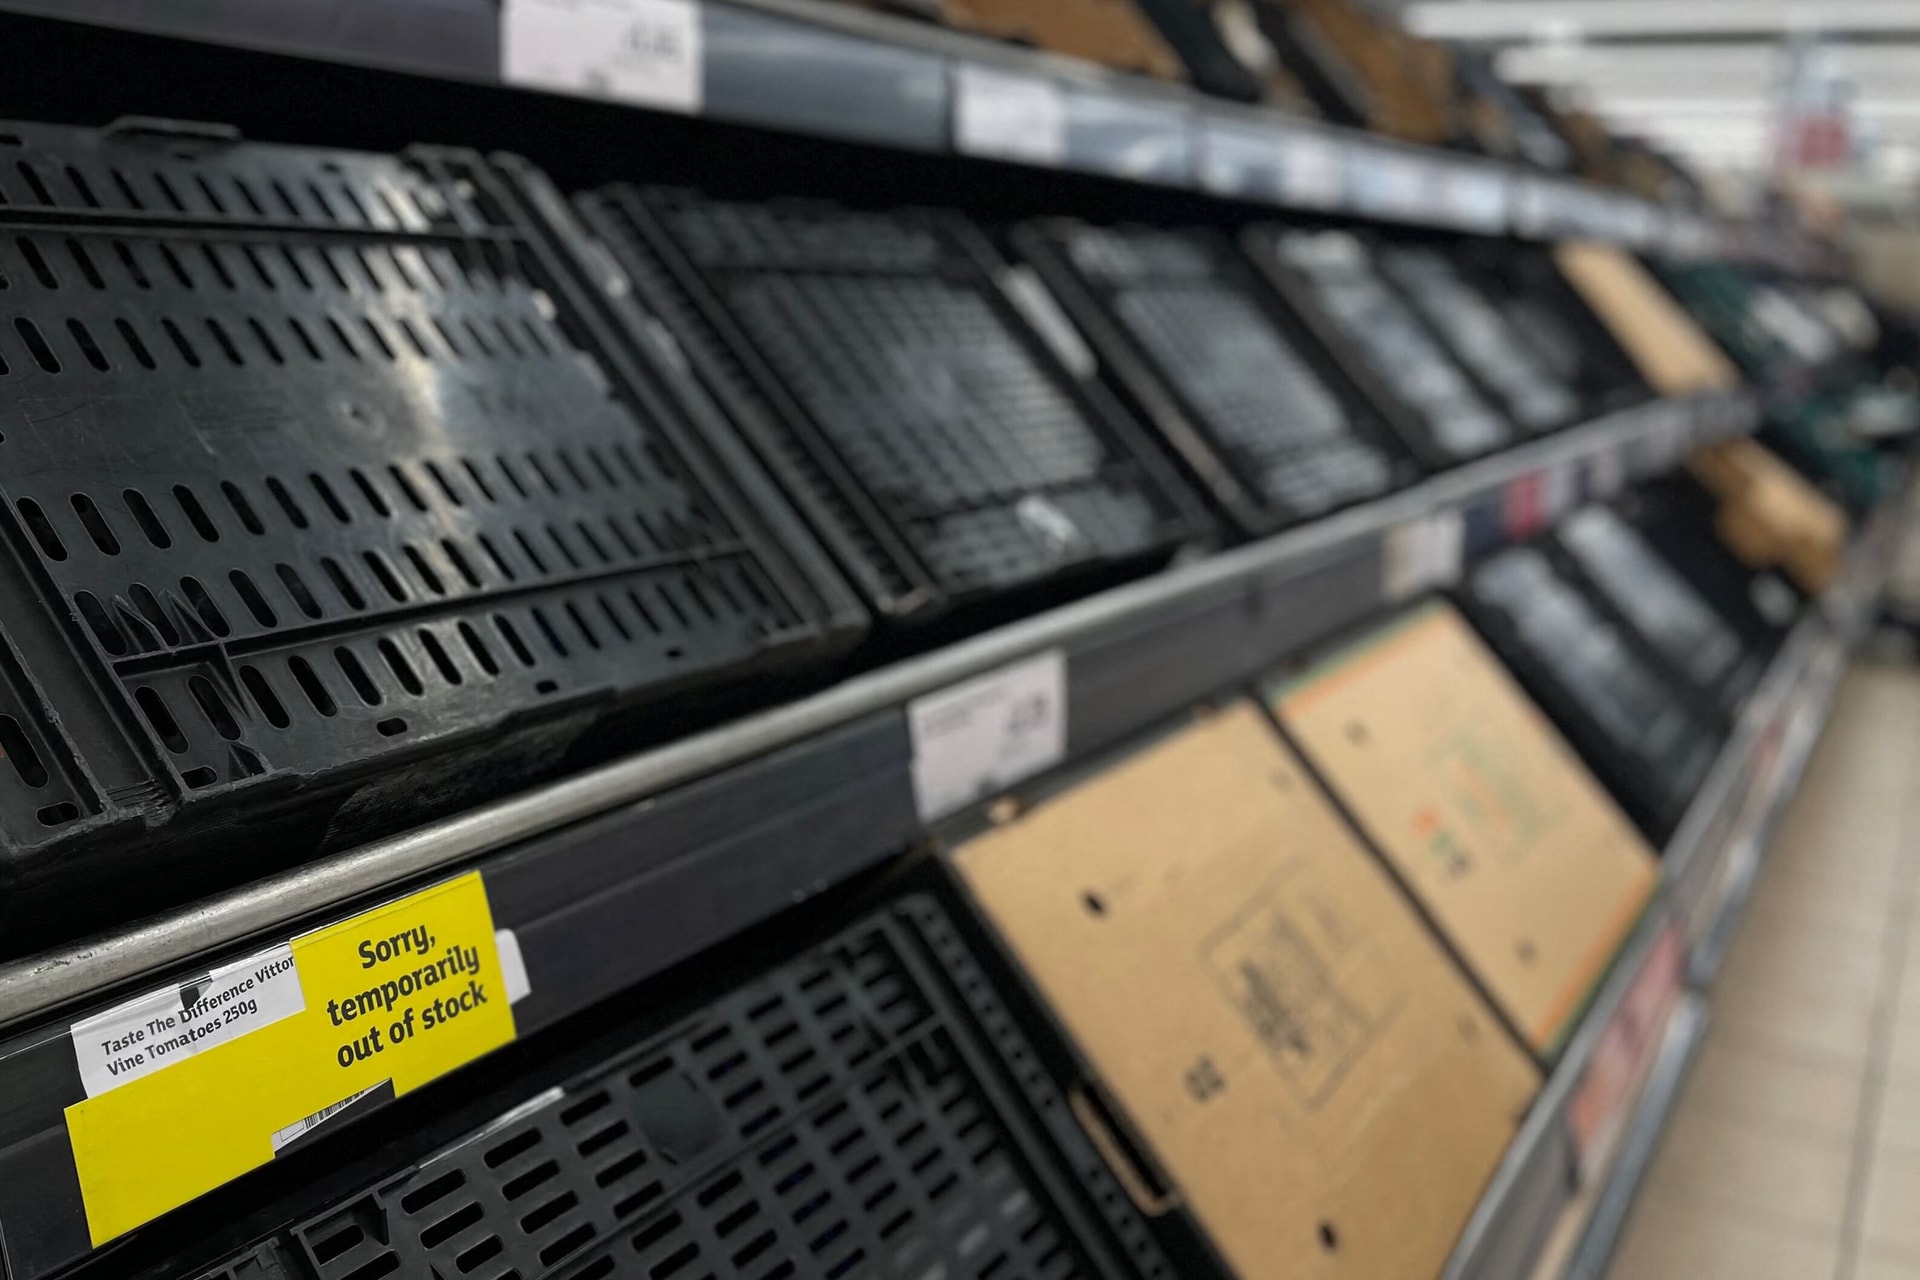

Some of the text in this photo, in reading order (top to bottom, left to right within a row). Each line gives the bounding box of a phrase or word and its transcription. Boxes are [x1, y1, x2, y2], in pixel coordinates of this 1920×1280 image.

[327, 945, 480, 1027] temporarily
[358, 925, 436, 969] Sorry,
[101, 1030, 145, 1056] Taste
[147, 1016, 176, 1036] The
[178, 978, 255, 1024] Difference
[107, 998, 258, 1076] Vine Tomatoes 250g
[337, 980, 488, 1068] out of stock
